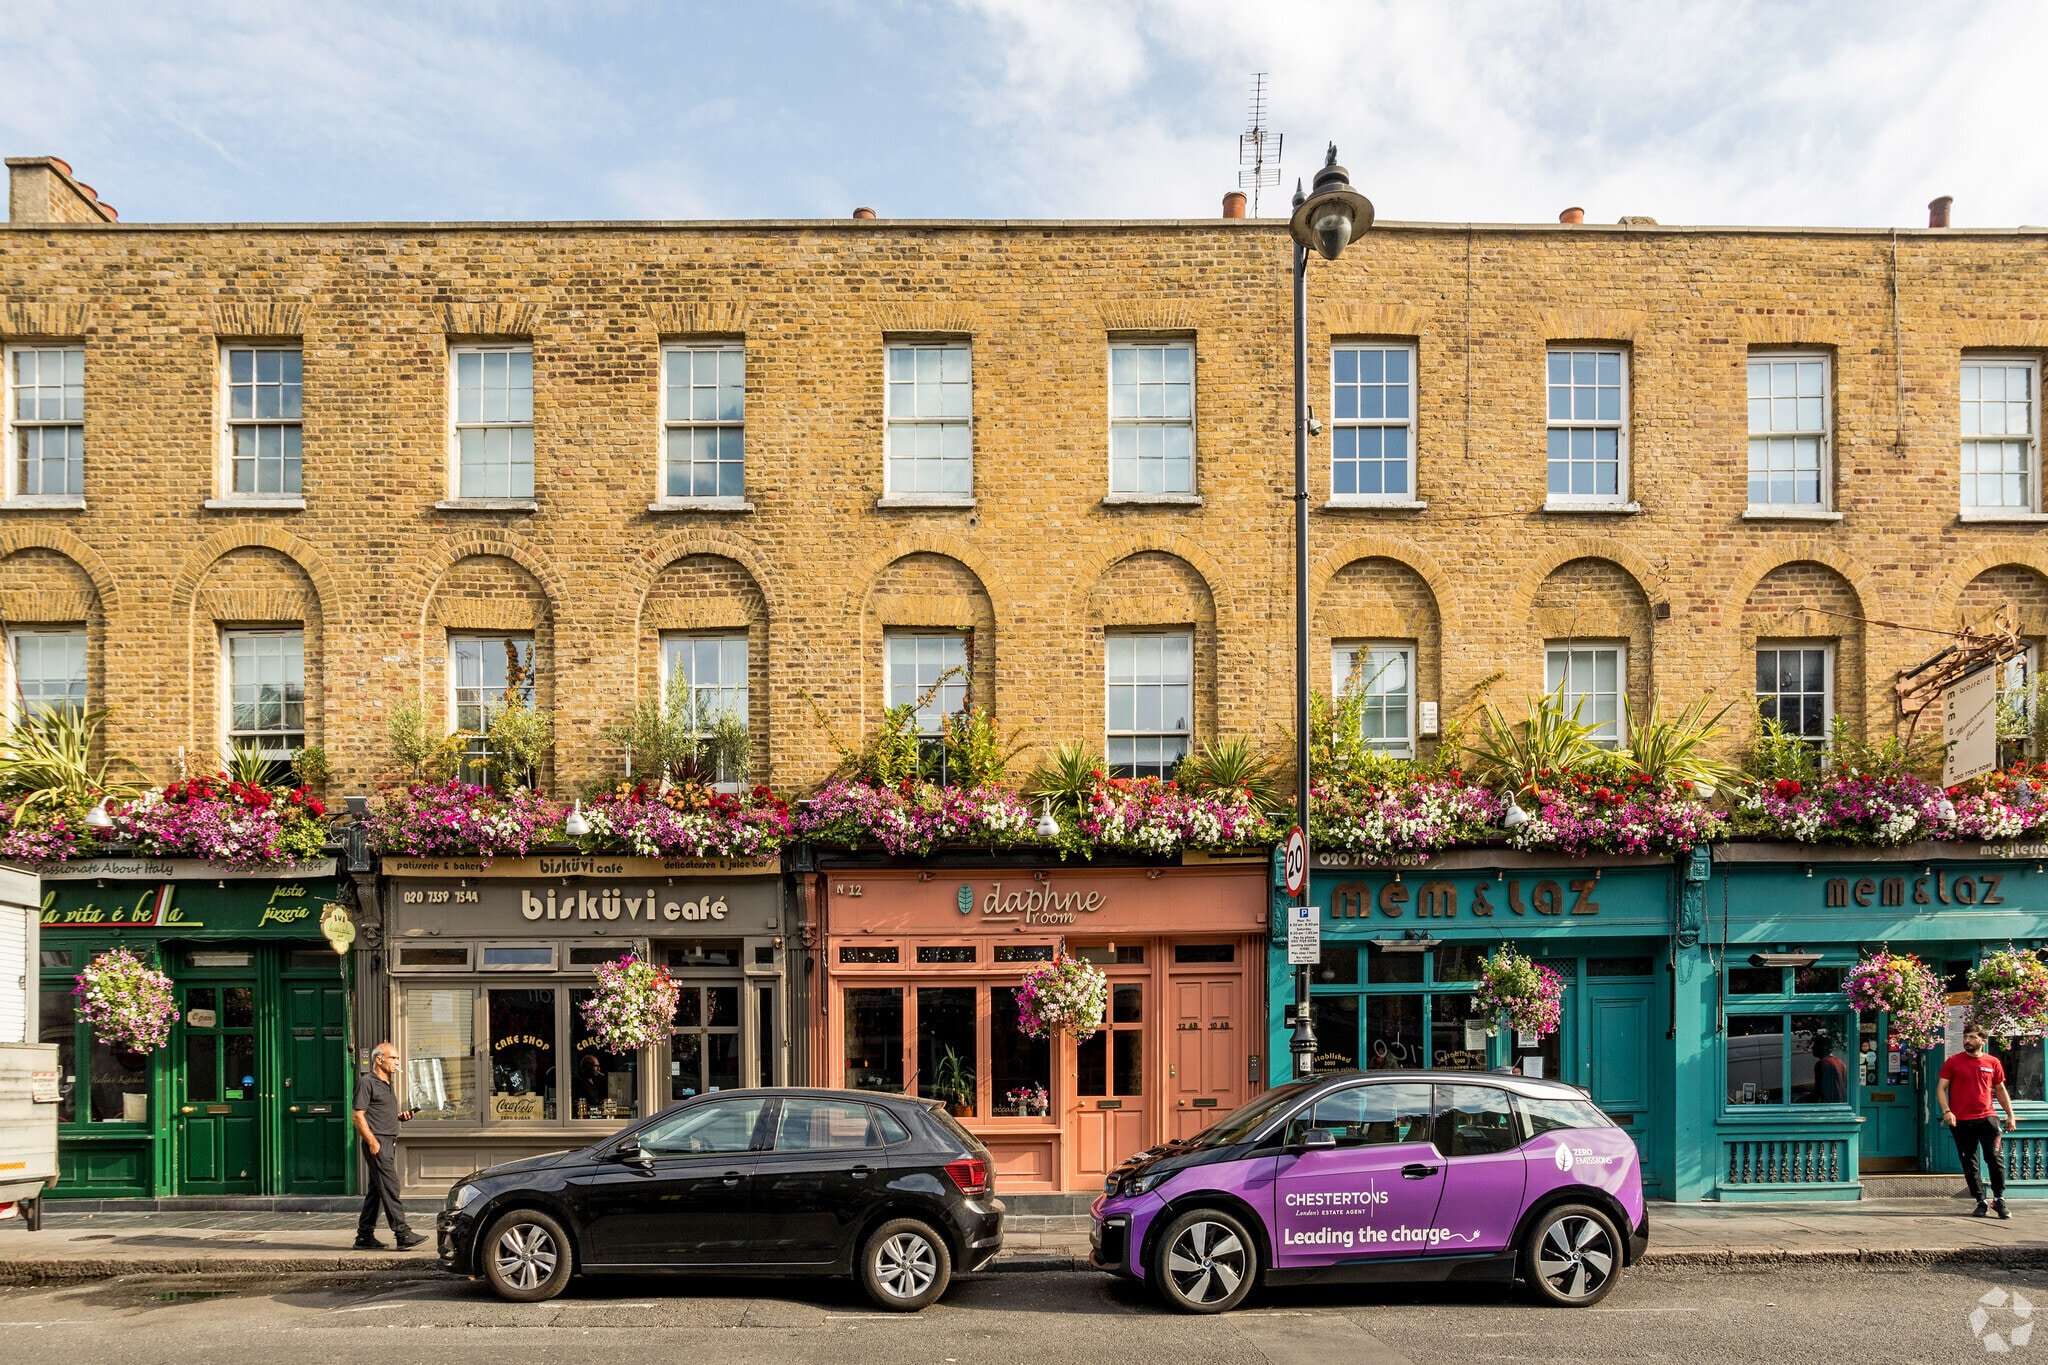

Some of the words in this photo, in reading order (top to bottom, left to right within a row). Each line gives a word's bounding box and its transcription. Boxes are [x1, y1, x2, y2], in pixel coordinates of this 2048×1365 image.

[1959, 674, 1991, 694] brasserie
[291, 861, 322, 872] 7984
[539, 857, 595, 874] bisküvi
[597, 862, 623, 874] café
[664, 860, 716, 870] delicatessen
[719, 860, 725, 869] &
[728, 860, 751, 870] juice
[753, 859, 767, 868] bar
[1288, 845, 1302, 879] 20
[1319, 852, 1350, 866] 020
[35, 862, 100, 875] Passionate
[101, 862, 142, 874] About
[144, 862, 173, 876] Italy
[396, 862, 439, 871] patisserie
[443, 862, 449, 870] &
[453, 862, 485, 873] bakery
[267, 883, 307, 905] pasta
[403, 891, 424, 904] 020
[427, 891, 450, 904] 7359
[848, 884, 862, 896] 12
[1826, 877, 1905, 907] mem
[1914, 877, 1929, 905] &
[40, 890, 61, 923] la
[63, 903, 106, 923] vita
[521, 888, 657, 921] bisküvi
[663, 895, 729, 921] café
[982, 881, 1107, 923] daphne
[1331, 880, 1458, 919] mem
[1472, 881, 1494, 917] &
[257, 906, 310, 927] pizzeria
[1032, 910, 1077, 925] room
[191, 1011, 213, 1023] Open
[495, 1034, 519, 1050] CAKE
[522, 1034, 550, 1050] SHOP
[577, 1035, 601, 1051] CAKE
[1313, 1052, 1352, 1064] stablished
[1575, 1156, 1613, 1165] EMISSIONS
[1285, 1191, 1389, 1206] CHESTERTONS
[1284, 1227, 1354, 1248] Leading
[1358, 1225, 1388, 1243] the
[1391, 1224, 1451, 1246] charge
